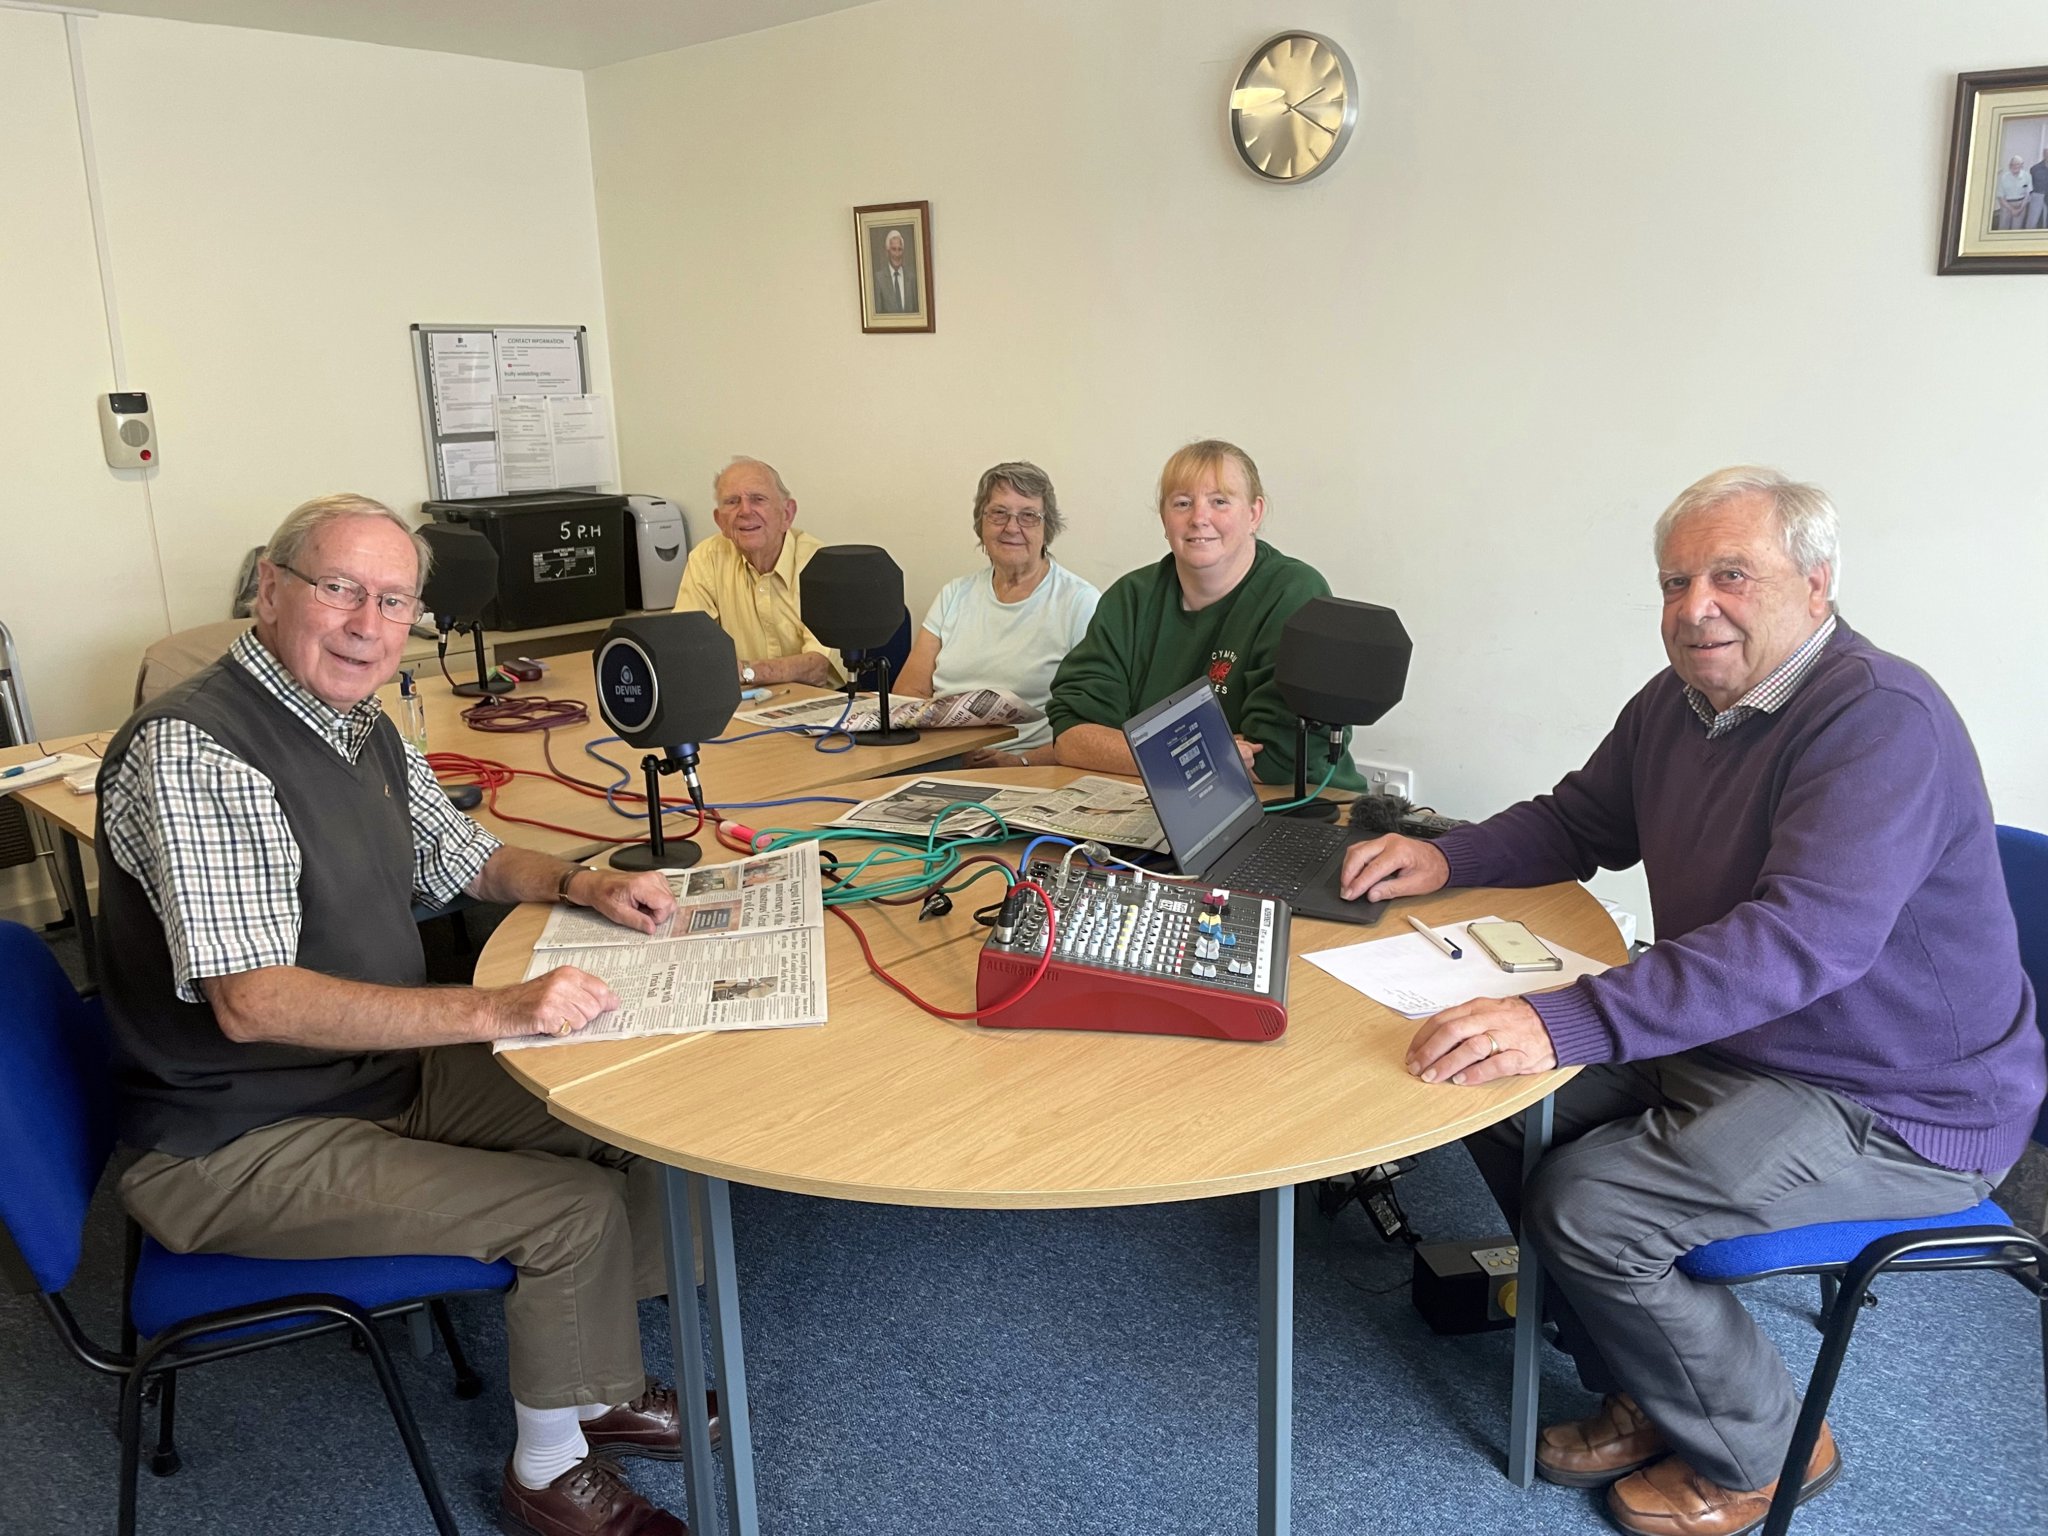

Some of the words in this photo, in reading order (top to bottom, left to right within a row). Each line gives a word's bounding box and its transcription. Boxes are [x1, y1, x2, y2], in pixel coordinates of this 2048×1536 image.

[560, 521, 571, 540] 5
[615, 685, 642, 696] DEVINE
[790, 881, 800, 898] August
[791, 906, 800, 915] was
[790, 916, 801, 924] the
[661, 971, 676, 990] evening
[661, 991, 674, 1003] with
